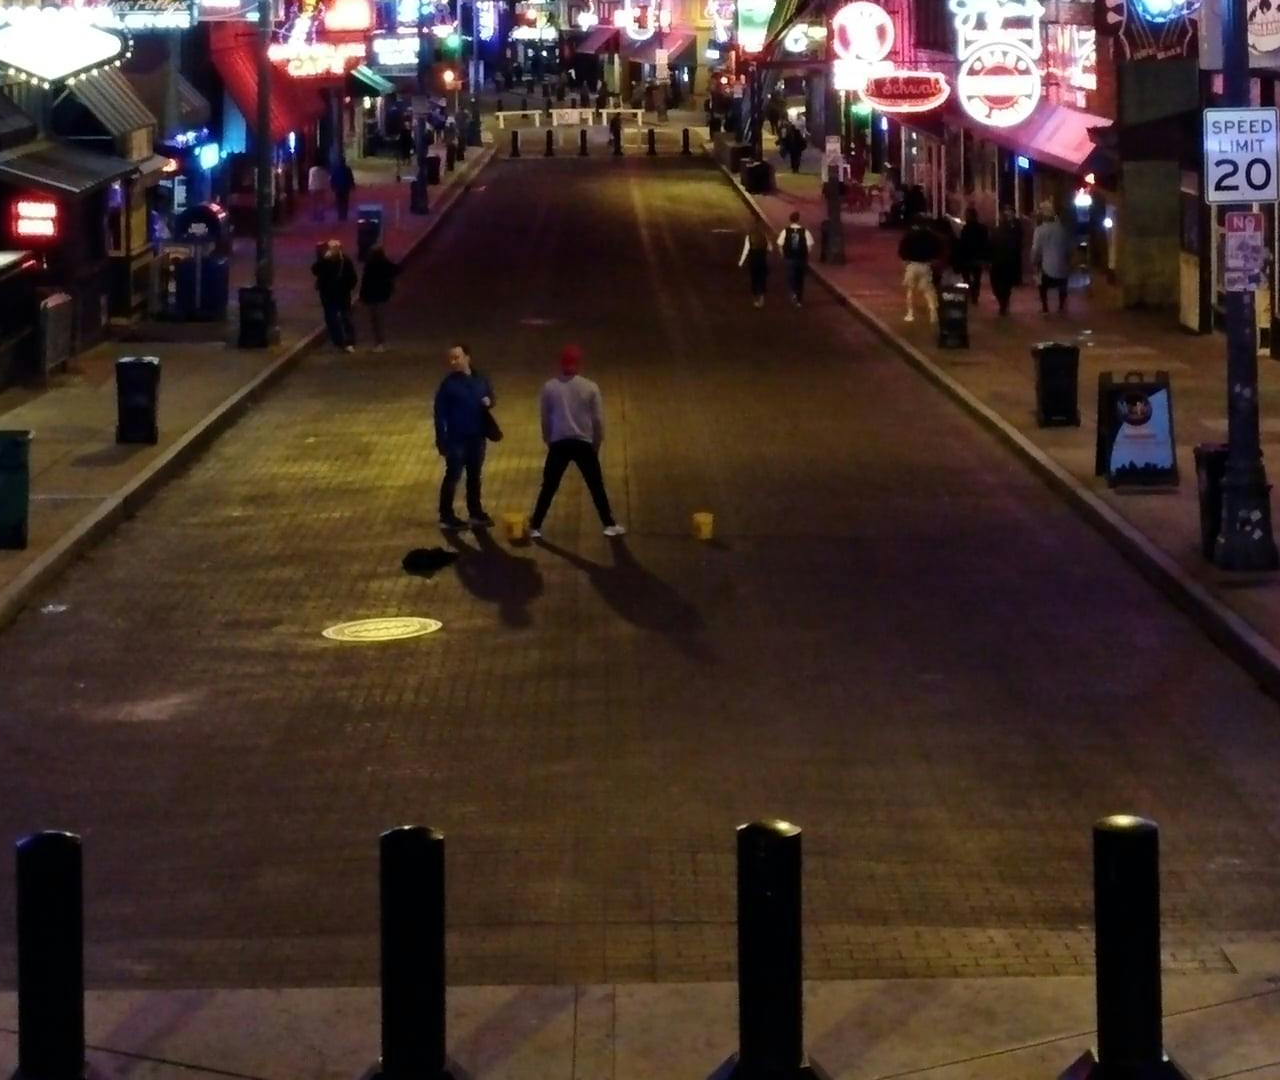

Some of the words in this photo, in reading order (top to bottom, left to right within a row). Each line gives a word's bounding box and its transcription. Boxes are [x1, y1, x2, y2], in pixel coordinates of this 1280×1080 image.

[1211, 119, 1273, 135] SPEED
[1218, 138, 1266, 154] LIMIT
[1213, 157, 1272, 192] 20
